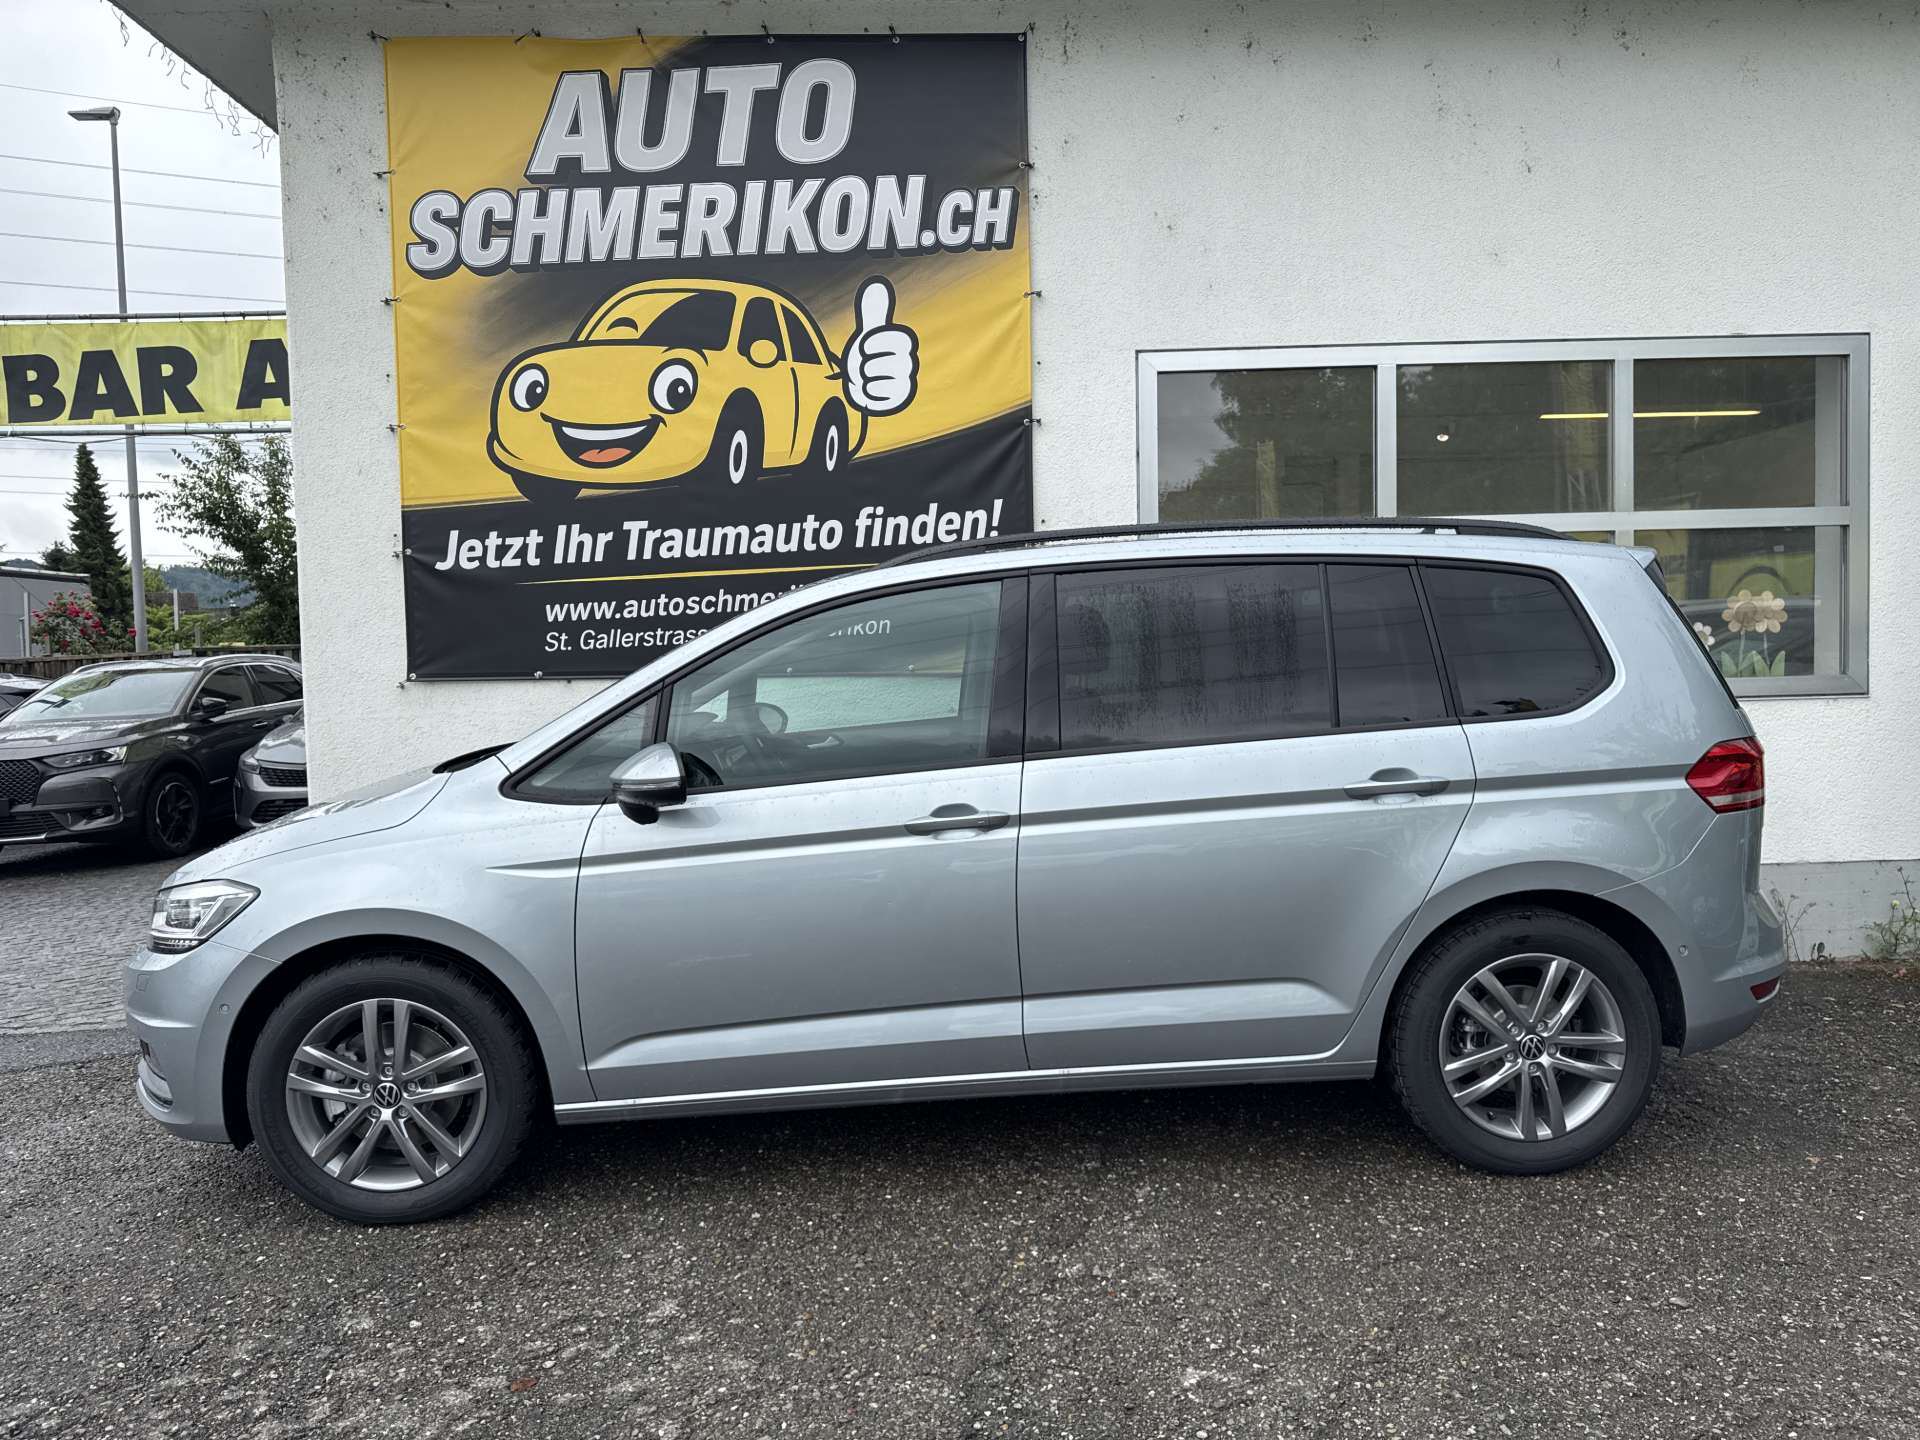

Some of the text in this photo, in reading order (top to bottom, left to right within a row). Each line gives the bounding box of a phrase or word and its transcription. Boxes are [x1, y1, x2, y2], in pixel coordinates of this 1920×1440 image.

[527, 57, 857, 175] AUTO
[409, 174, 1013, 272] SCHMERIKON.CH
[2, 345, 205, 424] BAR
[434, 498, 1004, 571] Jetzt Ihr Traumauto finden!
[545, 631, 573, 652] St.
